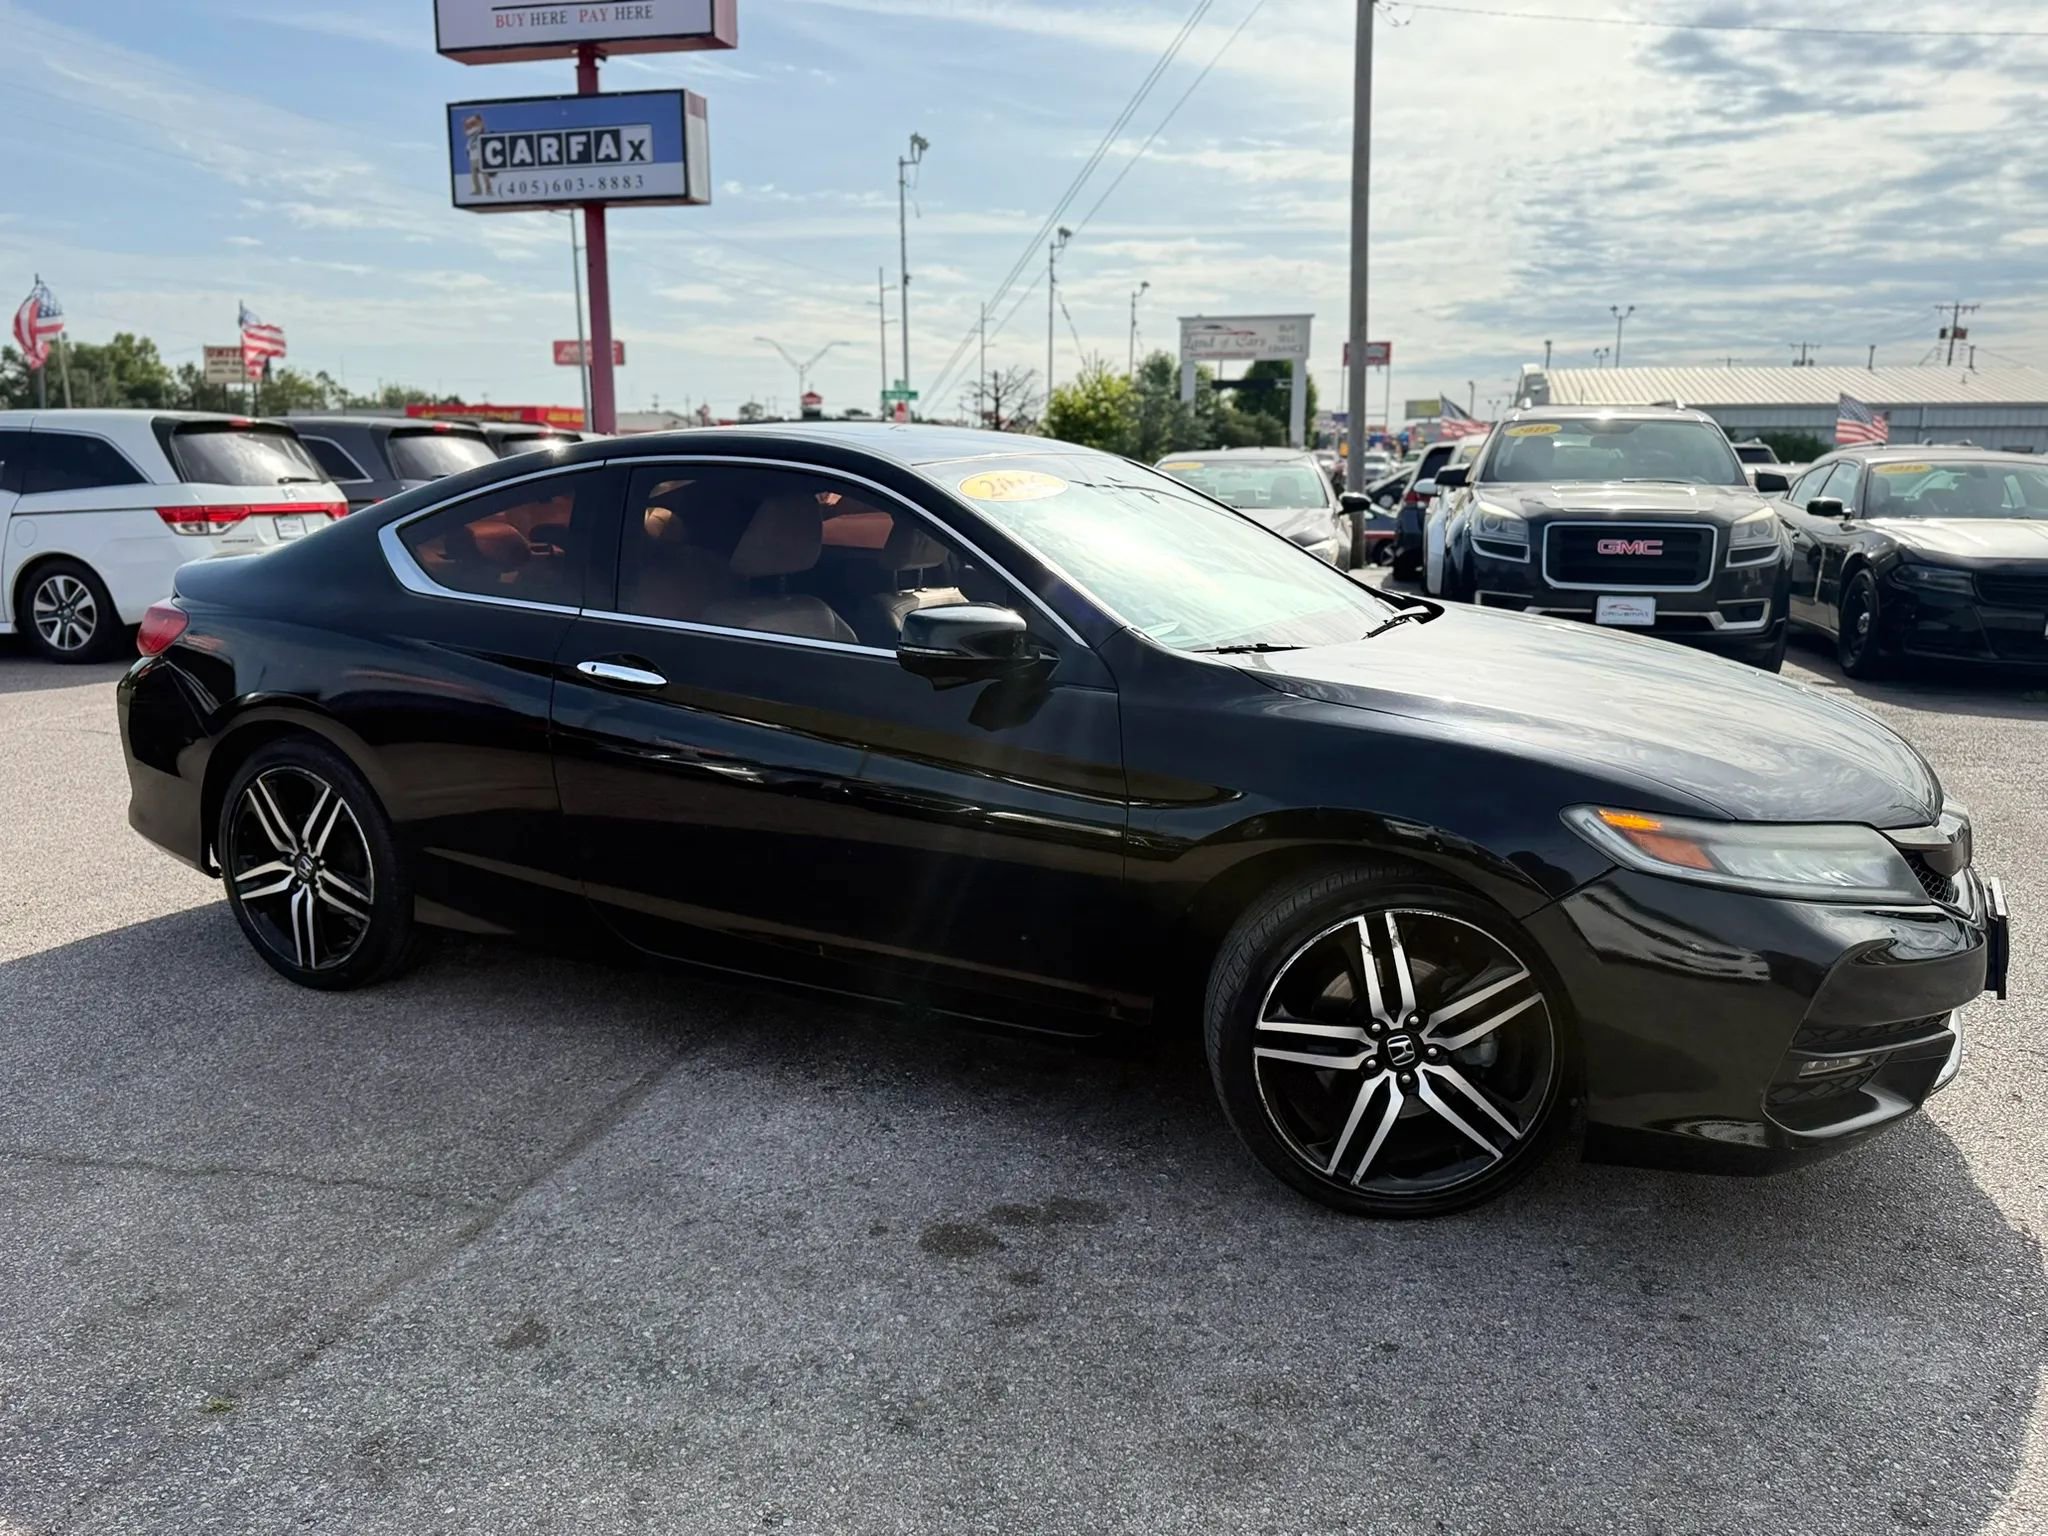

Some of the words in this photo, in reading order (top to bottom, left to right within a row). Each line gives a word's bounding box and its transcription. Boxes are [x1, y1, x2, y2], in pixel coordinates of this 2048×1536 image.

[495, 13, 526, 28] BUY
[530, 10, 568, 26] HERE
[579, 8, 609, 23] PAY
[615, 5, 653, 20] HERE
[498, 174, 645, 197] (405)603-8883
[1597, 539, 1664, 556] GMC
